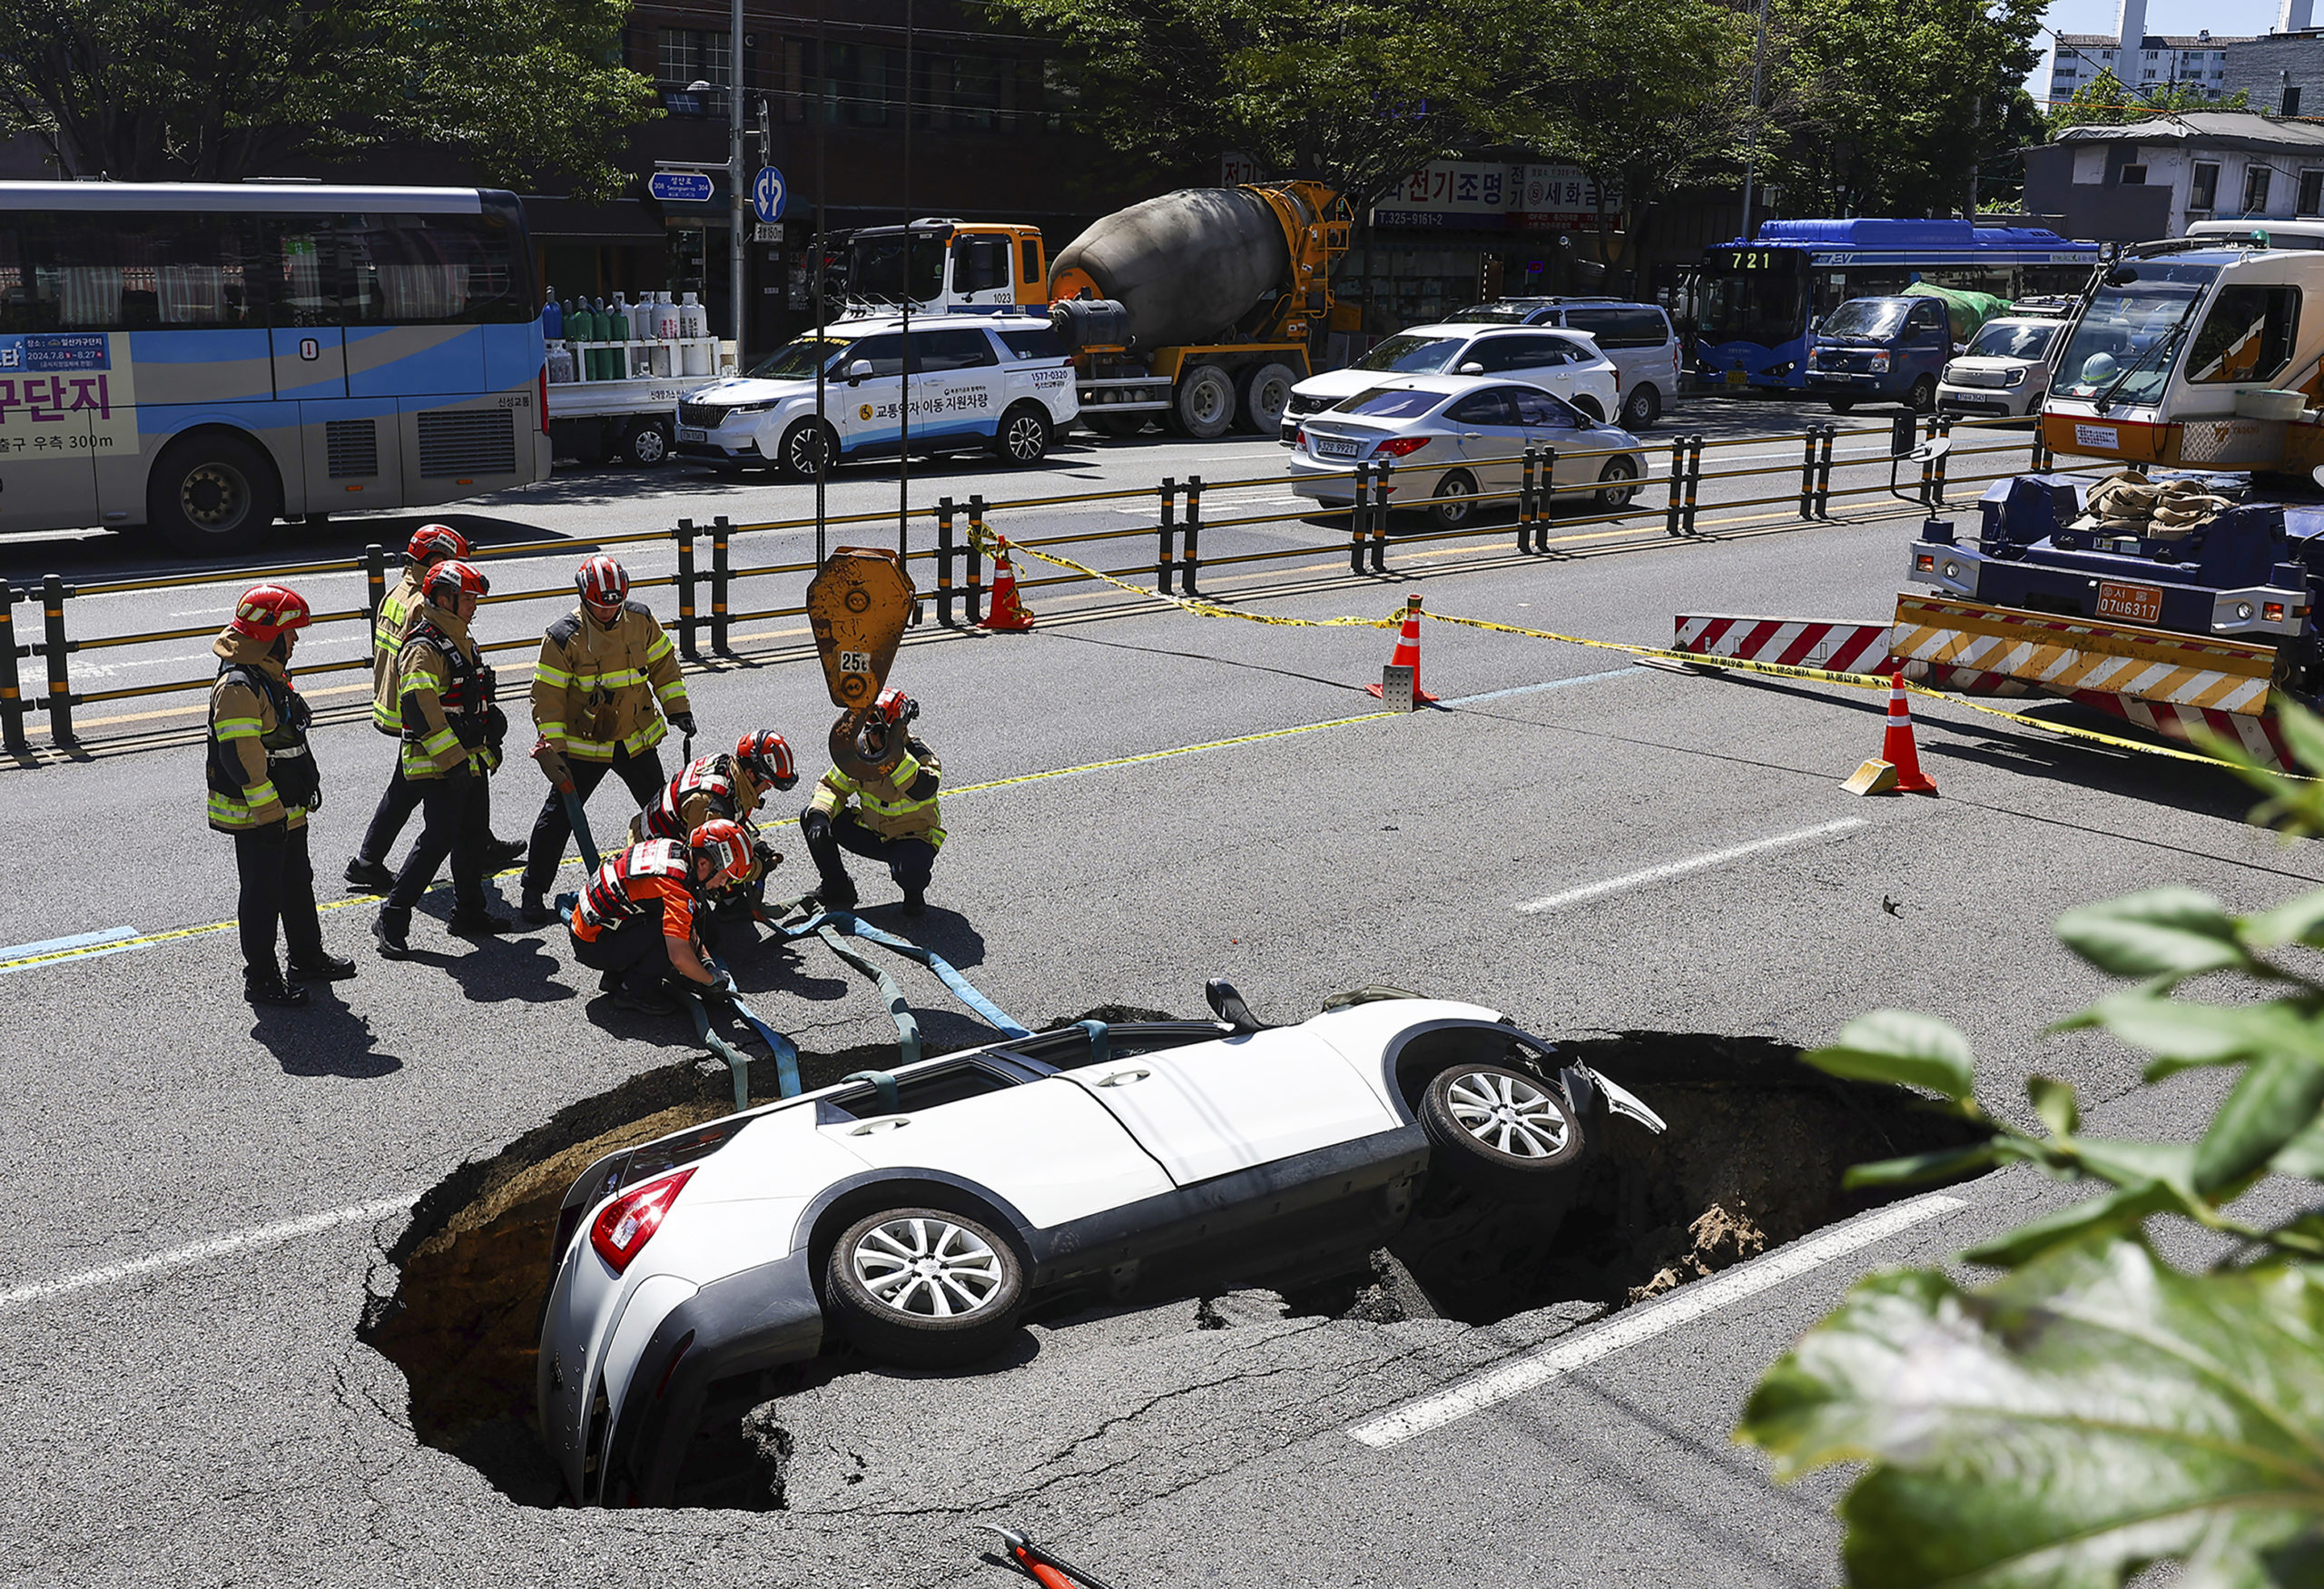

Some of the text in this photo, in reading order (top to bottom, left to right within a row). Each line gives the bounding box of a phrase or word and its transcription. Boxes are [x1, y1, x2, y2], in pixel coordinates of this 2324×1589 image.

[1732, 252, 1769, 269] 721
[993, 292, 1011, 304] 1023
[1031, 370, 1068, 381] 1577-0320
[922, 399, 944, 413] 이동
[945, 393, 989, 410] 지원차량
[34, 435, 63, 451] 우측
[69, 435, 113, 449] 300m
[1336, 443, 1354, 453] 9921
[2100, 598, 2157, 618] 07나6317
[842, 652, 868, 671] 25t
